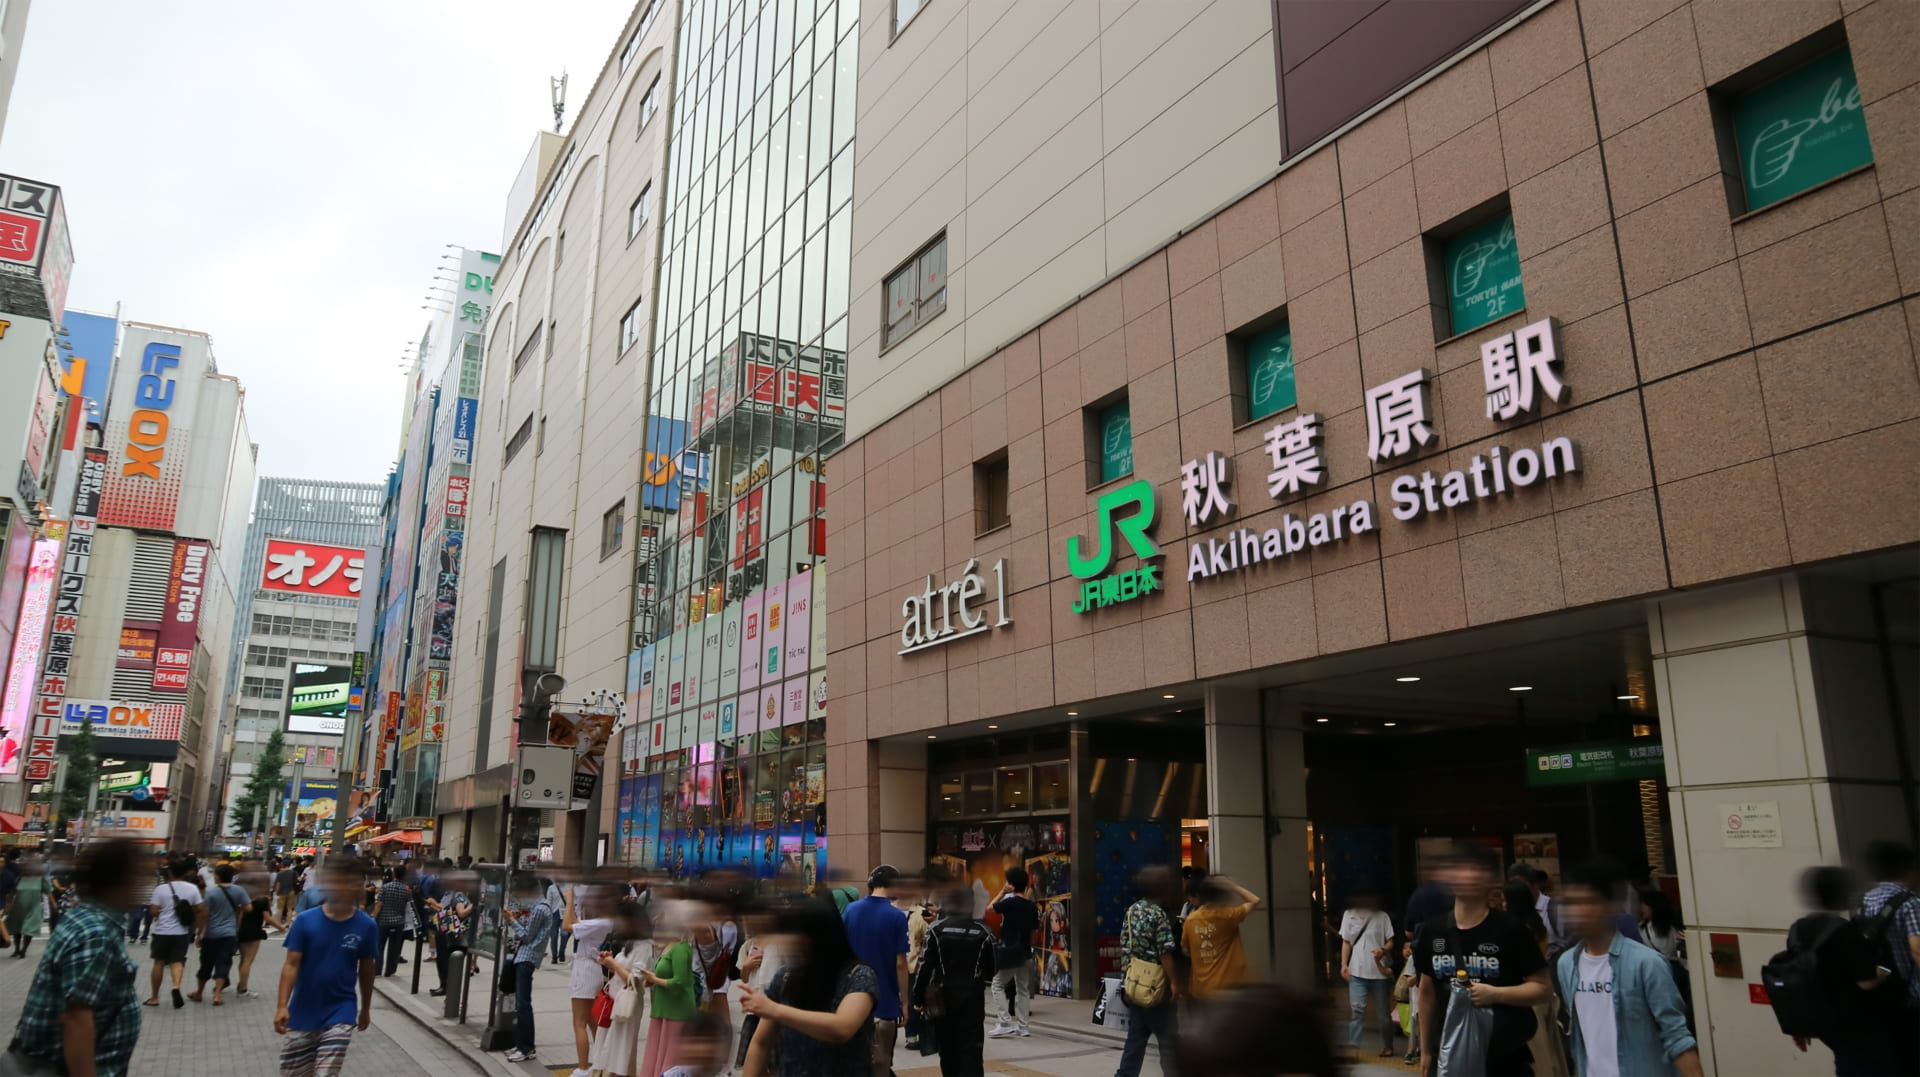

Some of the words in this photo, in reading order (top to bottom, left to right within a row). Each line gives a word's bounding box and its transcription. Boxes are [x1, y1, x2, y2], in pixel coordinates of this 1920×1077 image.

[1487, 296, 1507, 317] 2F
[1180, 316, 1568, 528] 秋葉原駅
[1066, 480, 1161, 579] JR
[1187, 499, 1378, 584] Akihabara
[1390, 436, 1579, 522] Station
[181, 544, 208, 584] Duty
[1071, 563, 1161, 615] JR東日本
[176, 585, 202, 623] Free
[901, 557, 986, 649] atré
